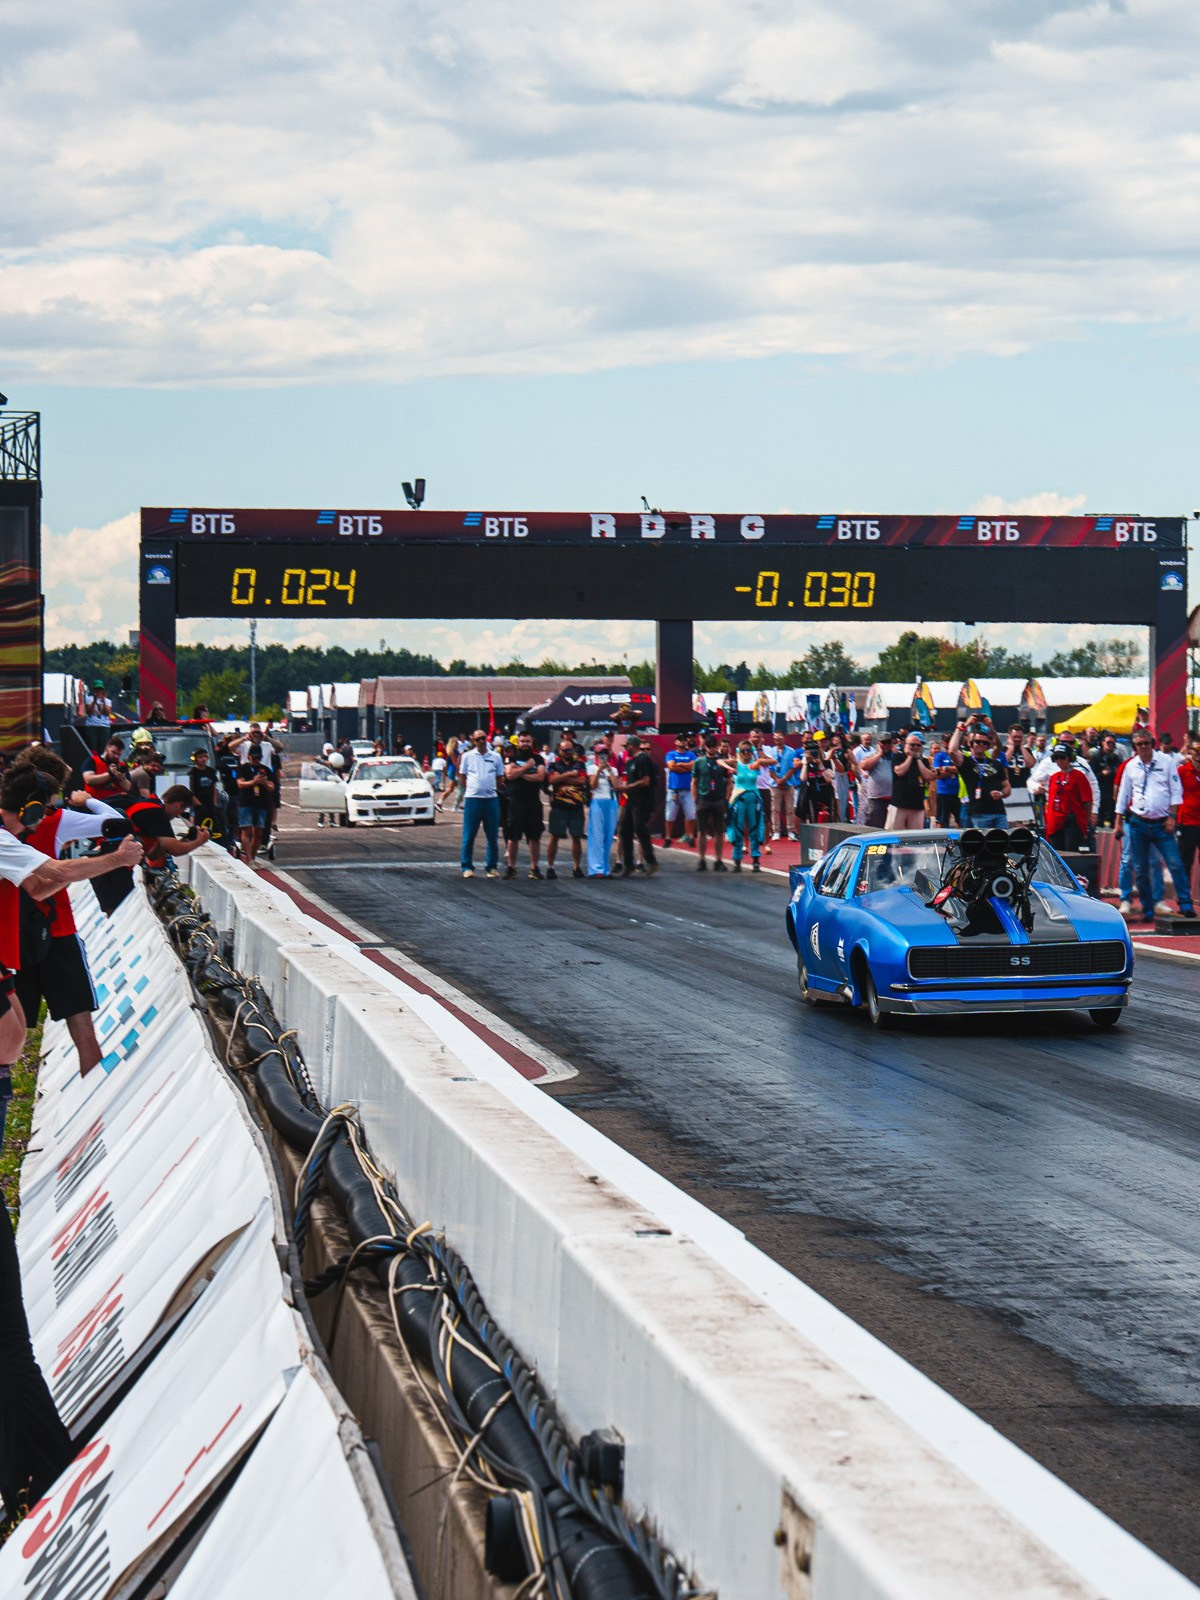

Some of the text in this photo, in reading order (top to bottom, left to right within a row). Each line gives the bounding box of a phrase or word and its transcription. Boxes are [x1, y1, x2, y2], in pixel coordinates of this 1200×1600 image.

[191, 514, 236, 534] ВТБ
[339, 515, 383, 536] ВТБ
[485, 517, 529, 537] ВТБ
[837, 520, 881, 540] ВТБ
[977, 521, 1020, 541] ВТБ
[1115, 522, 1158, 542] ВТБ
[231, 568, 357, 605] 0.024
[734, 571, 876, 607] -0.030
[1009, 956, 1031, 966] SS
